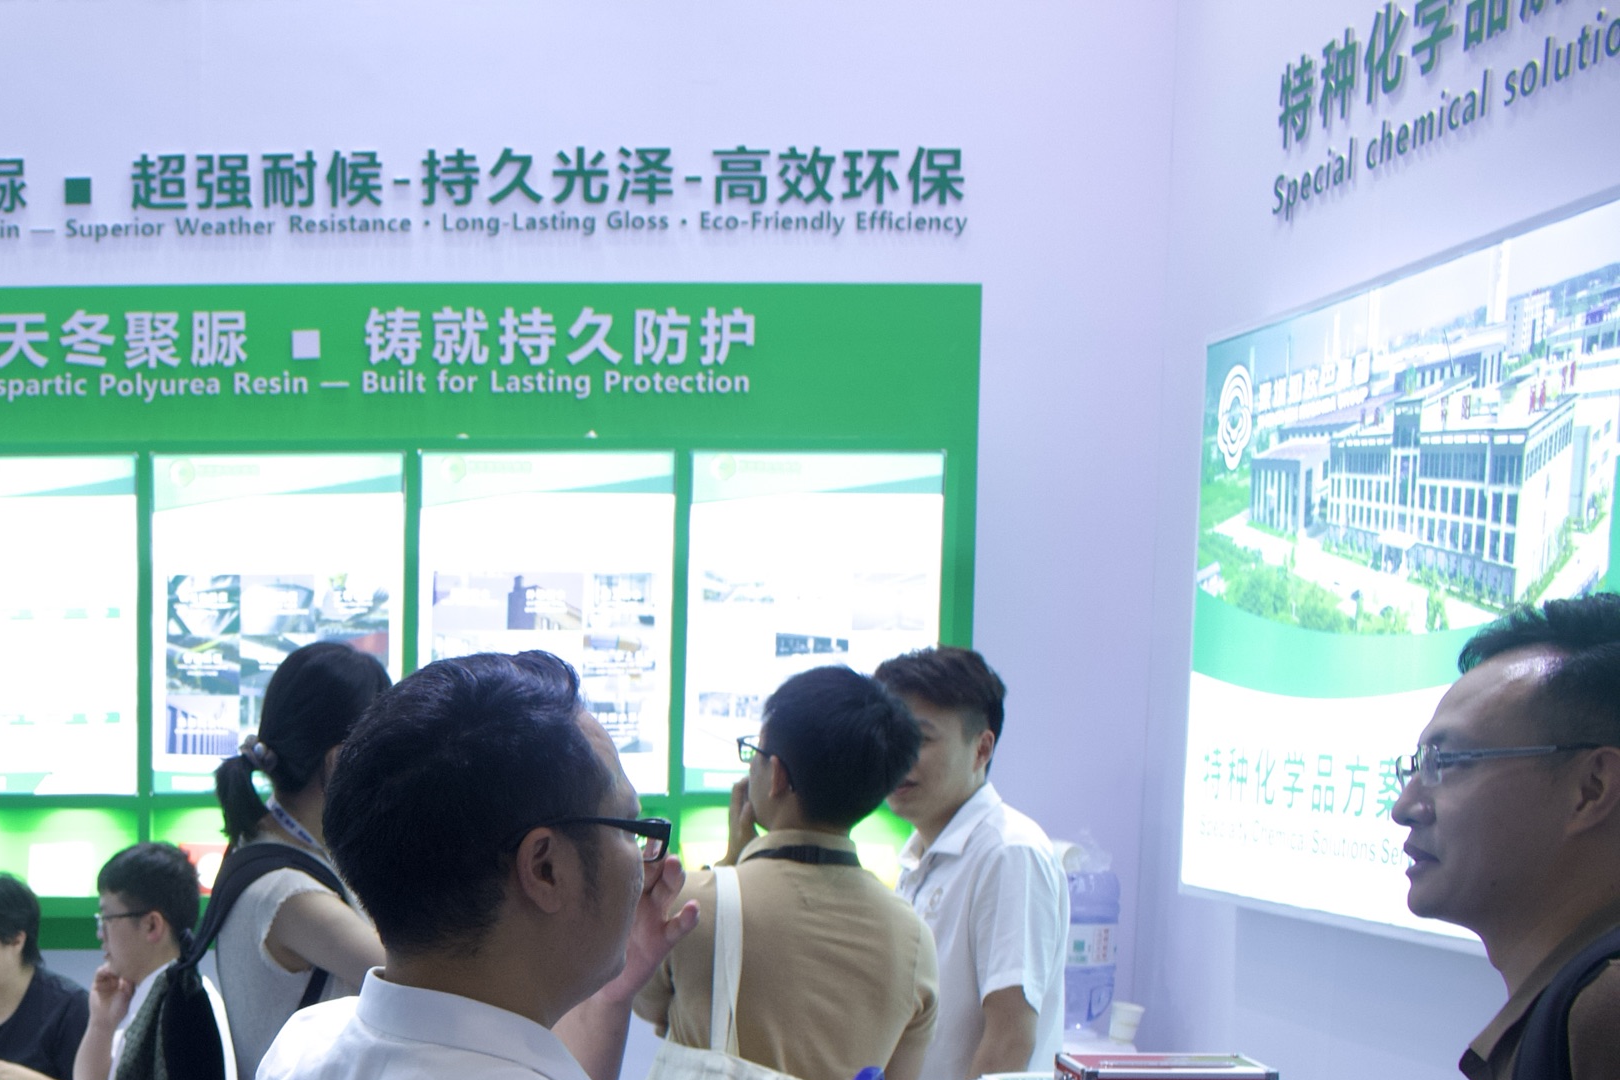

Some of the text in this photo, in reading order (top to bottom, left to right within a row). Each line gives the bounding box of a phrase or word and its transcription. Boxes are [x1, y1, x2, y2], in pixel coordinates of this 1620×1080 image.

[1272, 136, 1356, 221] Special
[1366, 69, 1491, 170] chemical
[131, 145, 966, 211] 超强耐候-持久光泽-高效环保
[64, 218, 165, 243] Superior
[176, 216, 275, 237] Weather
[288, 213, 412, 234] Resistance
[442, 212, 596, 237] Long-Lasting
[606, 211, 669, 231] Gloss
[700, 211, 845, 236] Eco-Friendly
[855, 211, 968, 238] Efficiency
[364, 306, 757, 366] 铸就持久防护
[99, 374, 221, 400] Polyurea
[233, 372, 309, 395] Resin
[362, 371, 426, 394] Built
[436, 371, 479, 393] for
[491, 371, 591, 399] Lasting
[604, 371, 750, 394] Protection
[1310, 829, 1377, 863] Solutions
